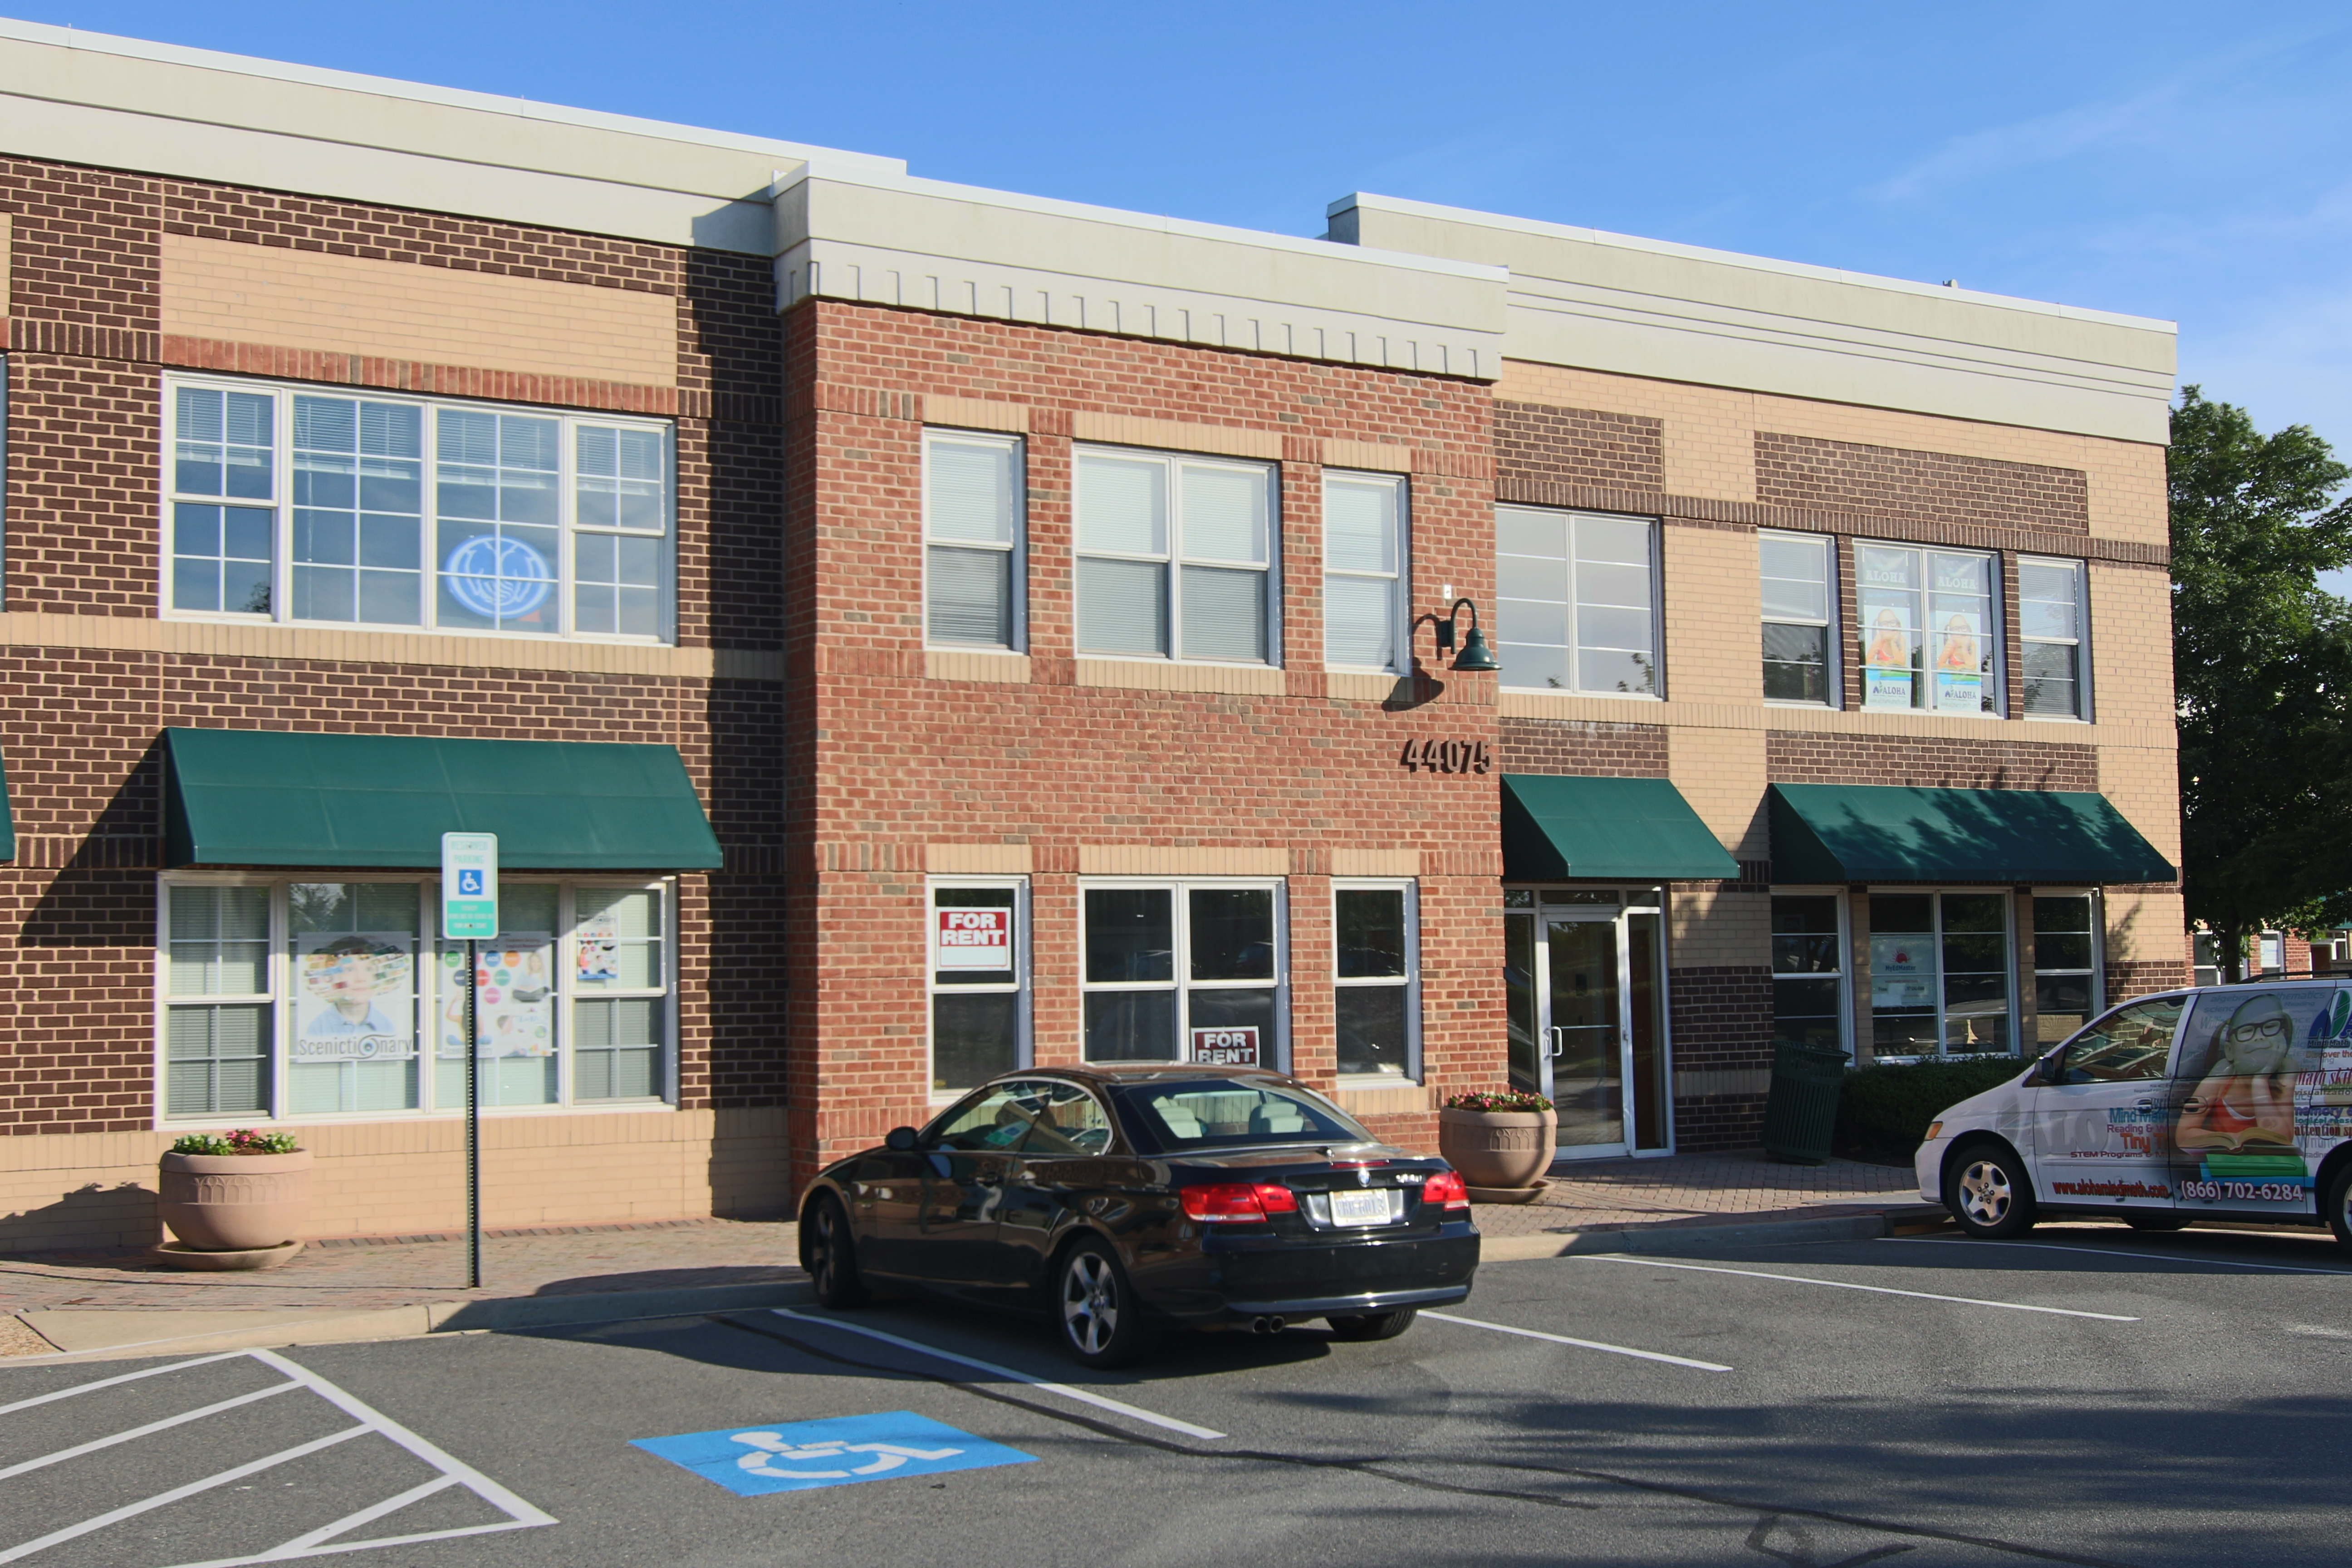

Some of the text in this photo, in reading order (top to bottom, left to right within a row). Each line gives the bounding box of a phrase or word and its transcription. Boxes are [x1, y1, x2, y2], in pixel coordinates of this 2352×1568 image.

[1866, 570, 1906, 583] ALOHA
[1938, 576, 1977, 589] ALOHA
[1883, 686, 1906, 695] ALOHA
[1954, 691, 1977, 699] ALOHA
[1405, 738, 1494, 773] 44075
[451, 841, 488, 850] RESERVED
[454, 855, 485, 864] PARKING
[948, 912, 997, 929] FOR
[941, 929, 1005, 945] RENT
[299, 1036, 413, 1058] Scenictionary
[1204, 1032, 1246, 1049] FOR
[2308, 1039, 2349, 1049] Mind Math
[1198, 1048, 1254, 1064] RENT
[2110, 1107, 2136, 1123] Mind
[2107, 1124, 2143, 1136] Reading
[2146, 1124, 2154, 1133] &
[2294, 1122, 2341, 1137] attention
[2120, 1133, 2151, 1153] Tiny
[2100, 1151, 2142, 1159] Programs
[2052, 1178, 2171, 1199] www.alohamindmath.com
[2180, 1180, 2304, 1202] (866) 702-6284
